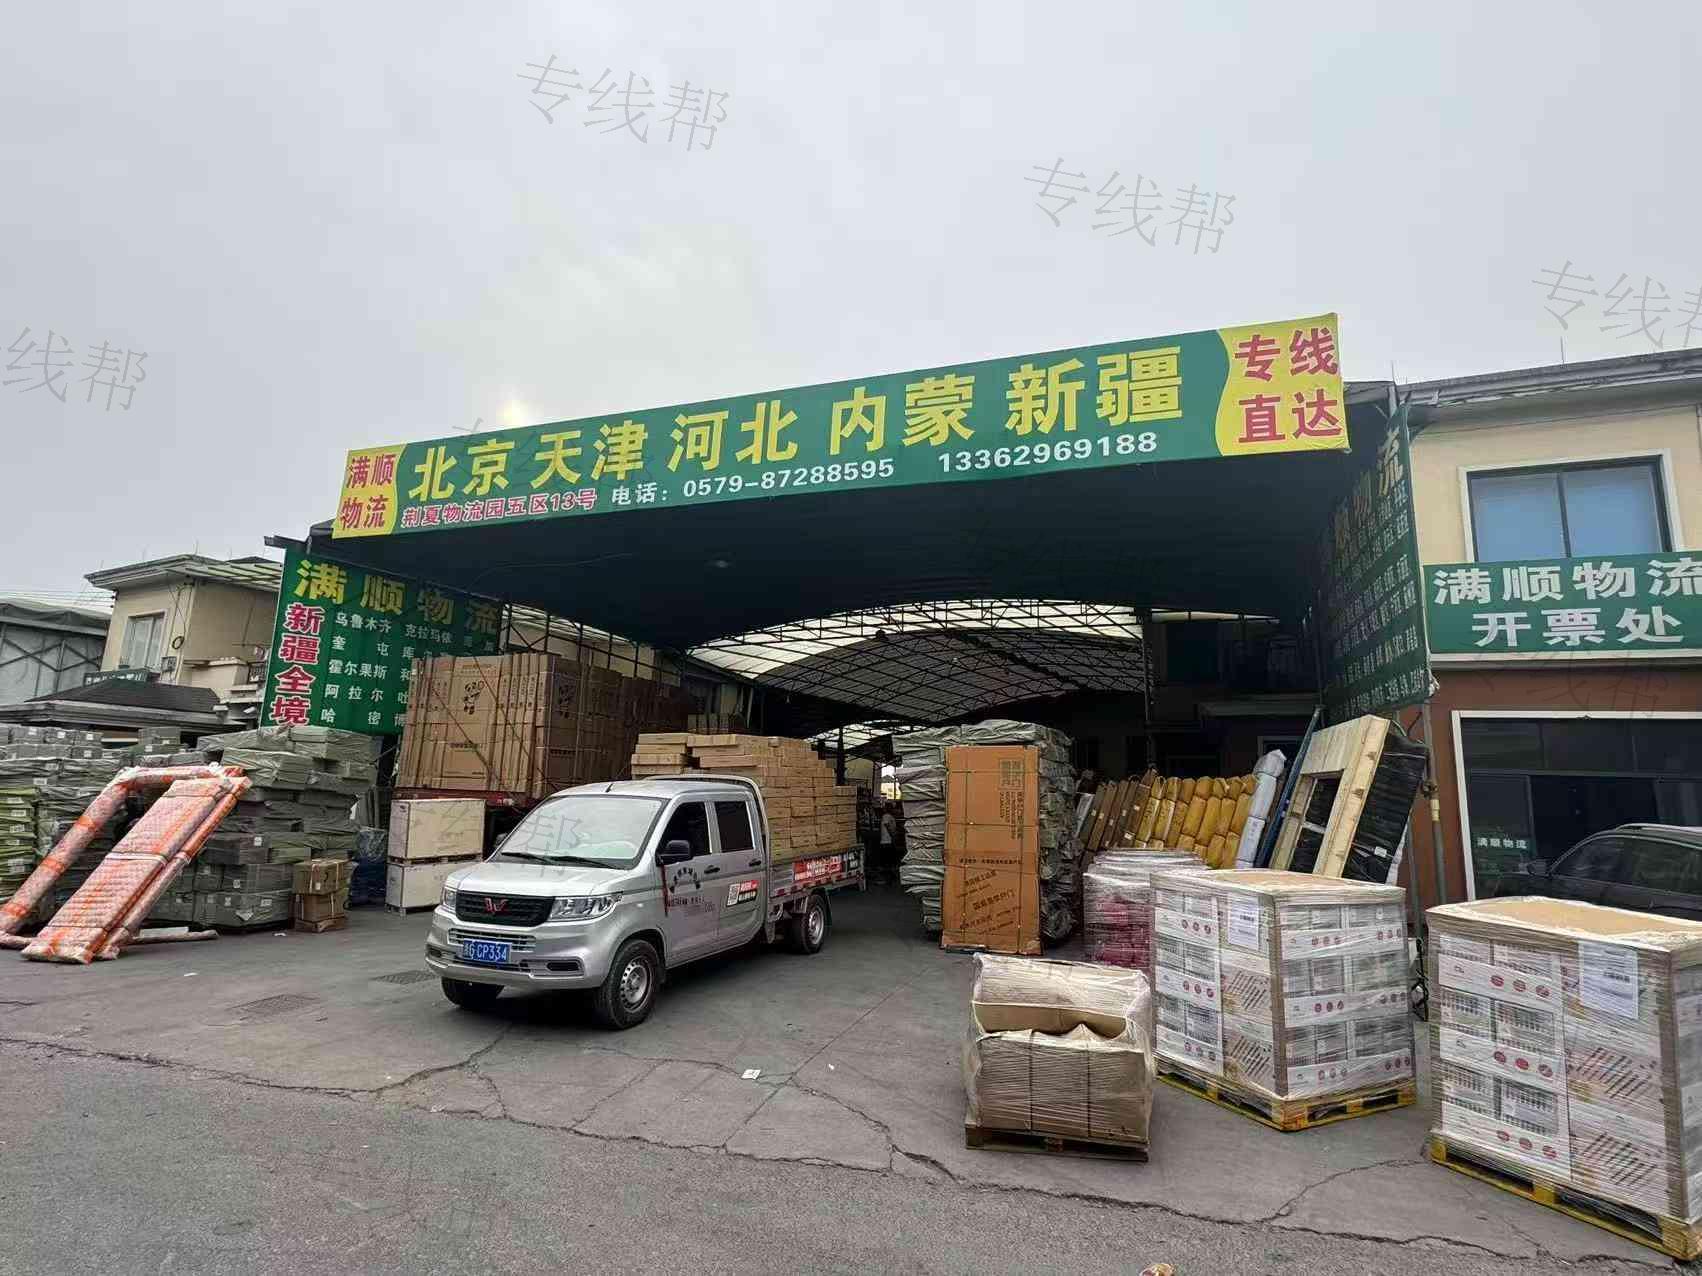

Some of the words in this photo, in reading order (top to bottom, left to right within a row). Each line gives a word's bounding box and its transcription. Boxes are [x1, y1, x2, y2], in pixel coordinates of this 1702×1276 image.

[1234, 327, 1339, 382] 专线
[408, 438, 515, 502] 北京
[530, 419, 649, 489] 天津
[667, 399, 799, 472] 河北
[829, 373, 976, 456] 内蒙
[1005, 345, 1183, 437] 新疆
[1238, 388, 1343, 443] 直达
[346, 453, 397, 489] 满顺
[683, 458, 895, 499] 0579-87288595
[938, 431, 1158, 473] 13362969188
[339, 494, 389, 530] 物流
[1433, 556, 1702, 606] 满顺物流
[335, 611, 392, 635] 乌鲁木齐
[1472, 605, 1684, 649] 开票处
[268, 602, 327, 727] 新疆全境
[327, 658, 388, 681] 霍尔果斯
[324, 683, 385, 704] 阿拉尔
[320, 707, 382, 727] 哈密
